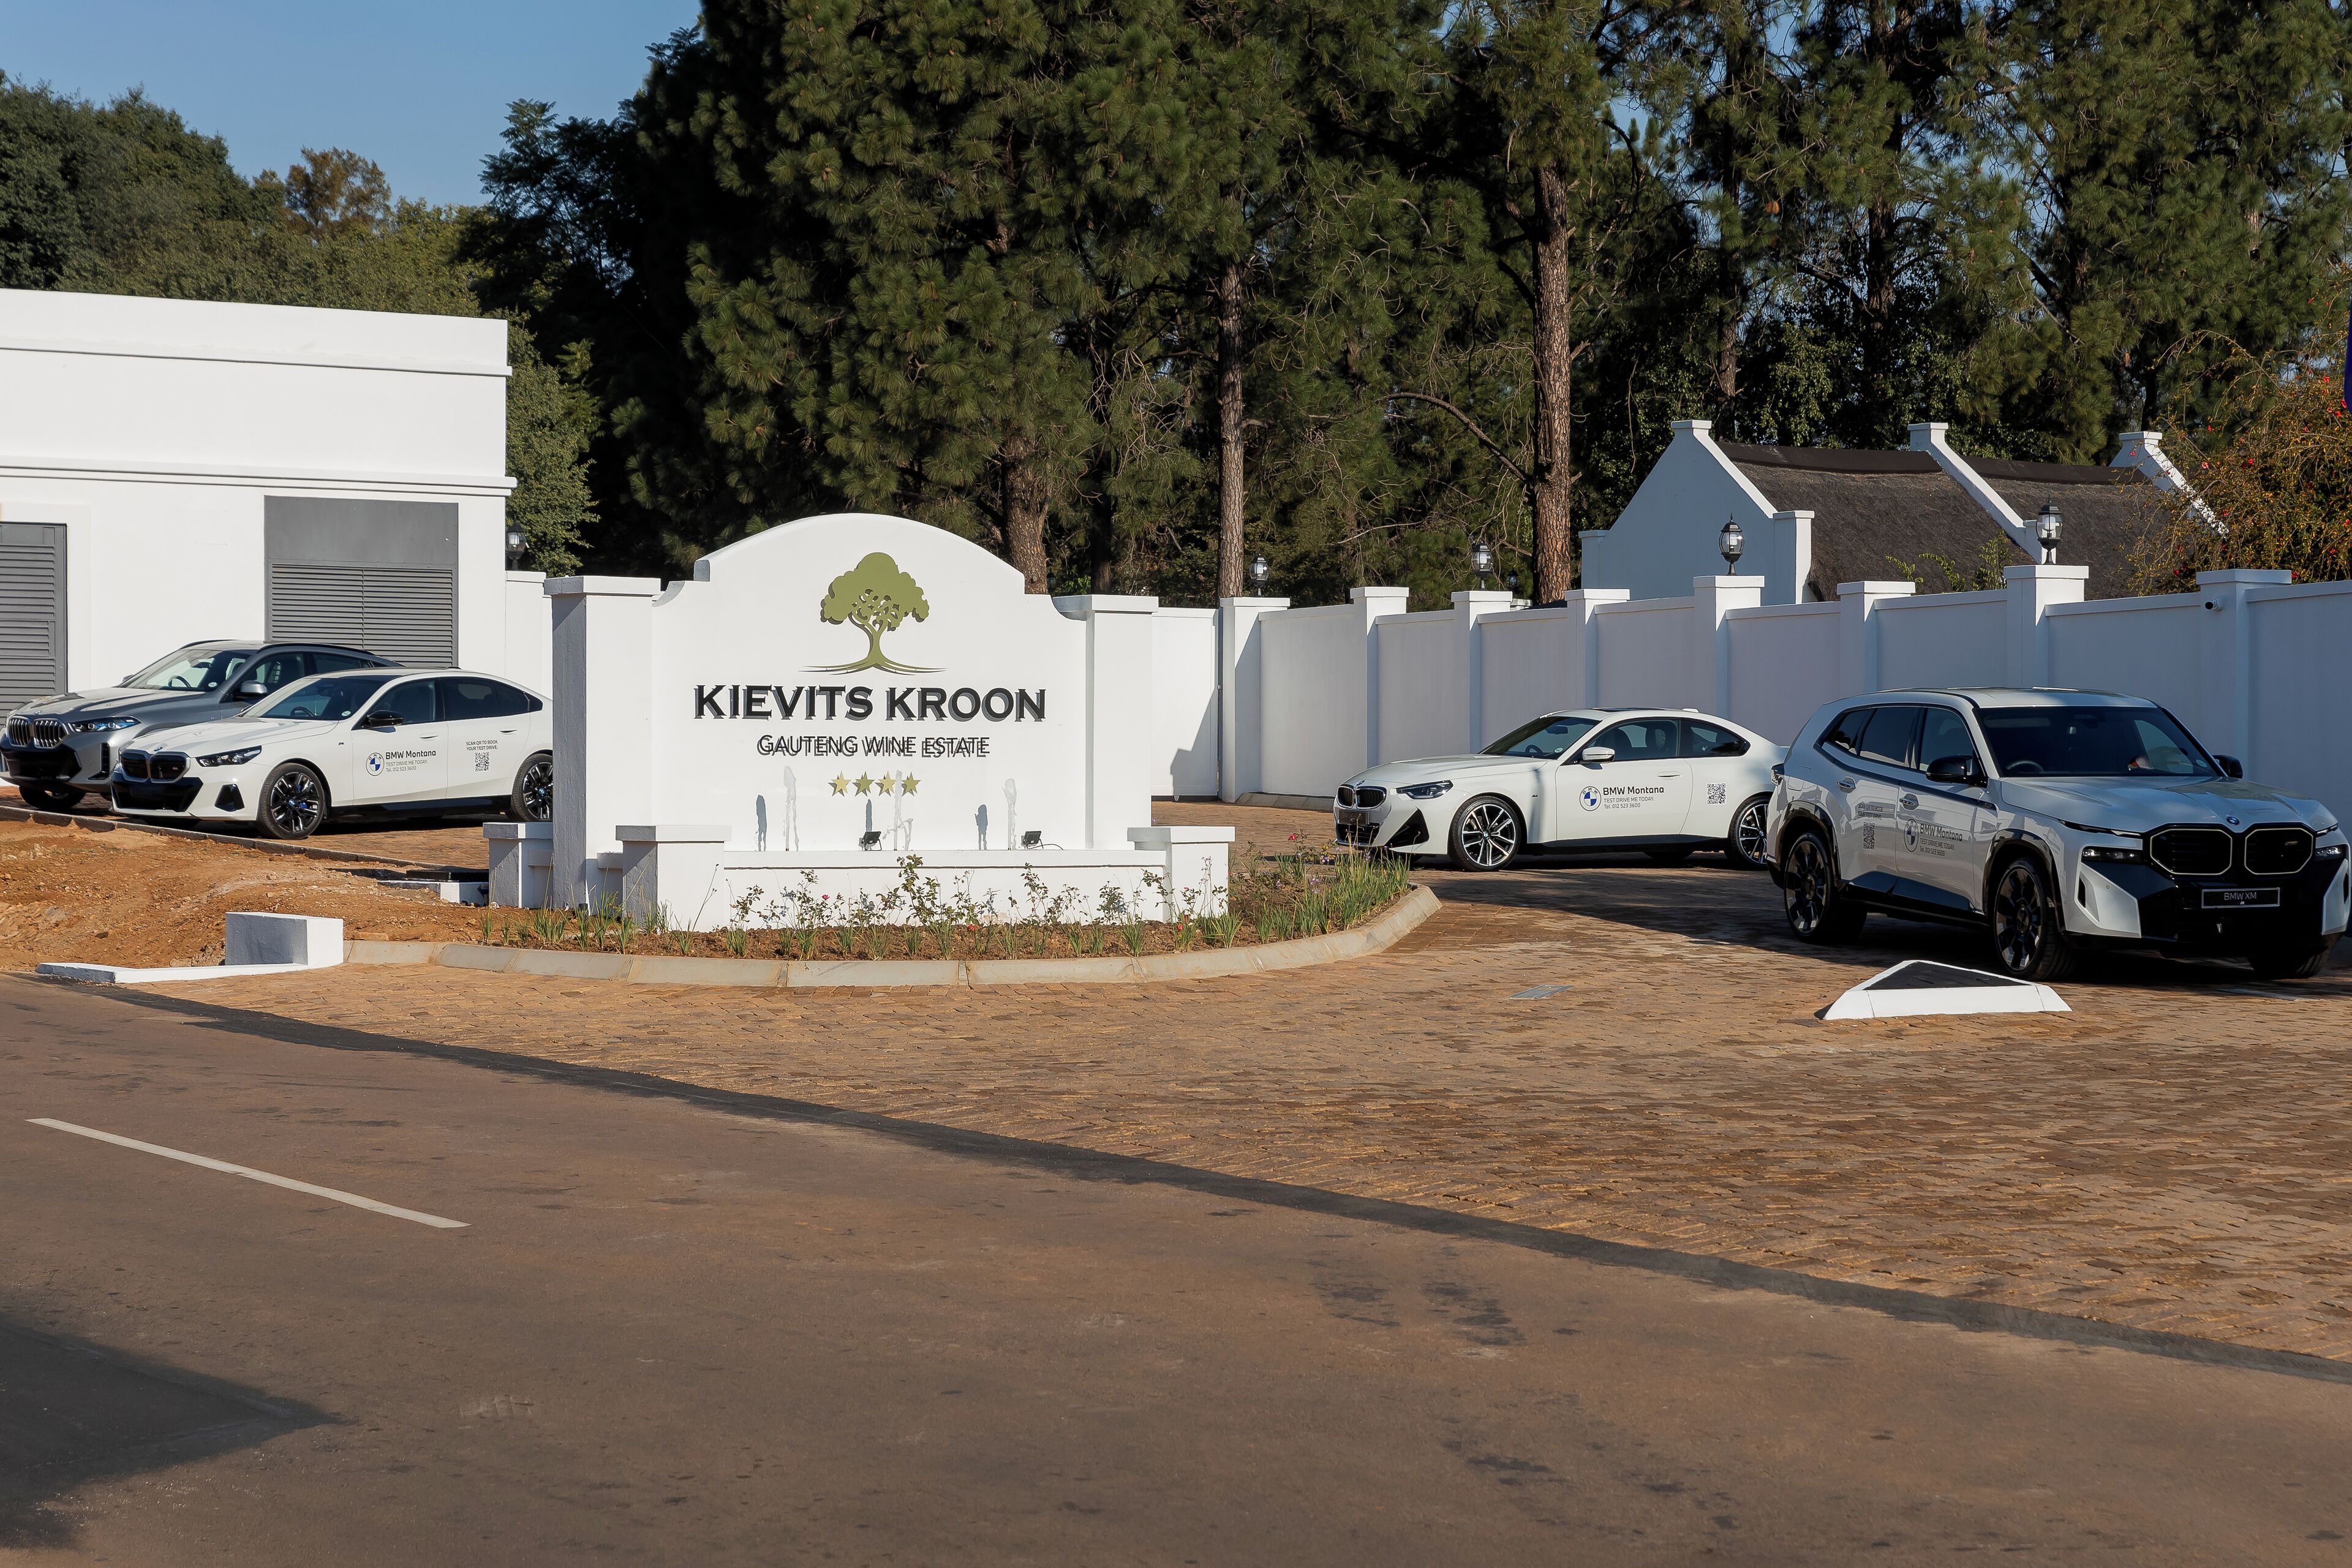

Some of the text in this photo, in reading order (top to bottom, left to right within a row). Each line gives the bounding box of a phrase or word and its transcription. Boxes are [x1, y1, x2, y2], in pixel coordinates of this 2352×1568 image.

[693, 684, 1047, 722] KIEVITS KROON
[385, 751, 404, 760] BMW
[757, 735, 990, 758] GAUTENG WINE ESTATE
[1603, 786, 1664, 795] BMW Montana
[1920, 823, 1962, 842] BMW Montana
